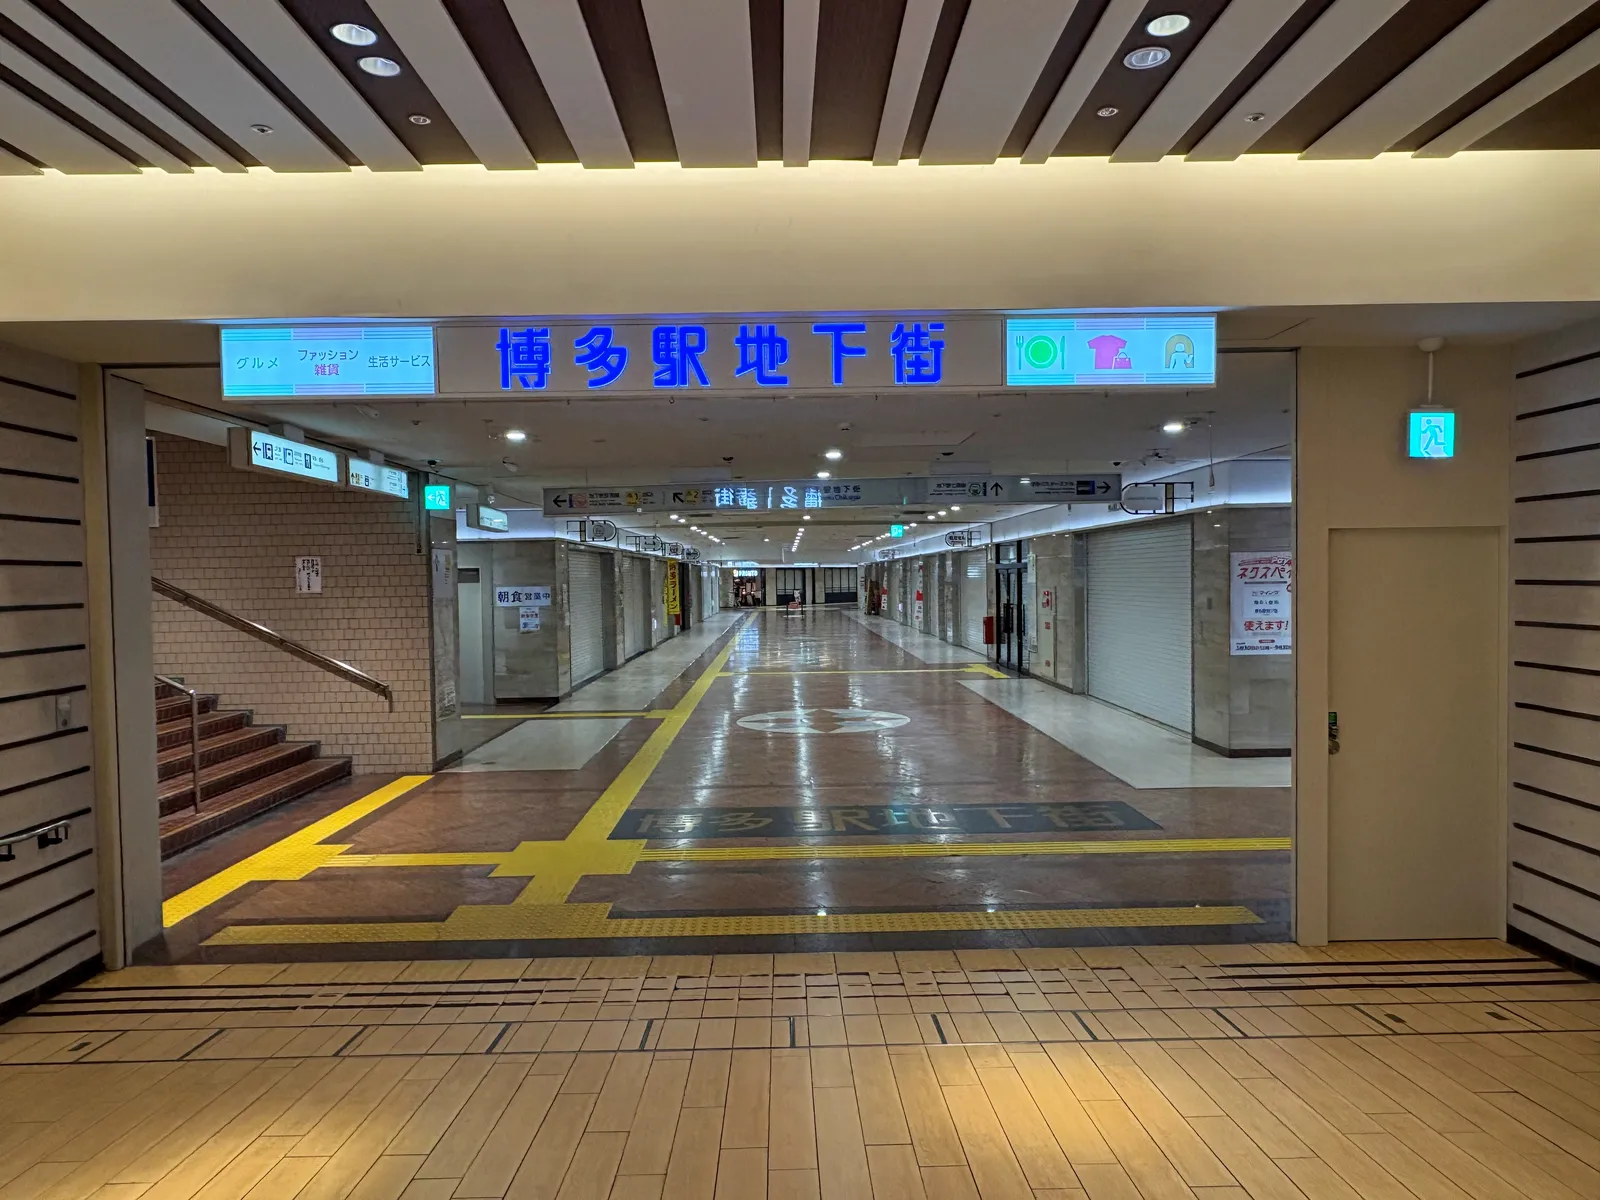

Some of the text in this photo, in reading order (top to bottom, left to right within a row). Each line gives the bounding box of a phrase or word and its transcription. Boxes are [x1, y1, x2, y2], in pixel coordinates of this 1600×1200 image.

[297, 348, 359, 361] ファッション
[496, 323, 946, 390] 博多駅地下街
[236, 357, 279, 370] グルメ
[368, 355, 431, 368] 生活サービス
[314, 363, 340, 376] 雑貨
[497, 590, 551, 604] 朝食営業中
[635, 801, 1130, 835] 博多駅地下街
